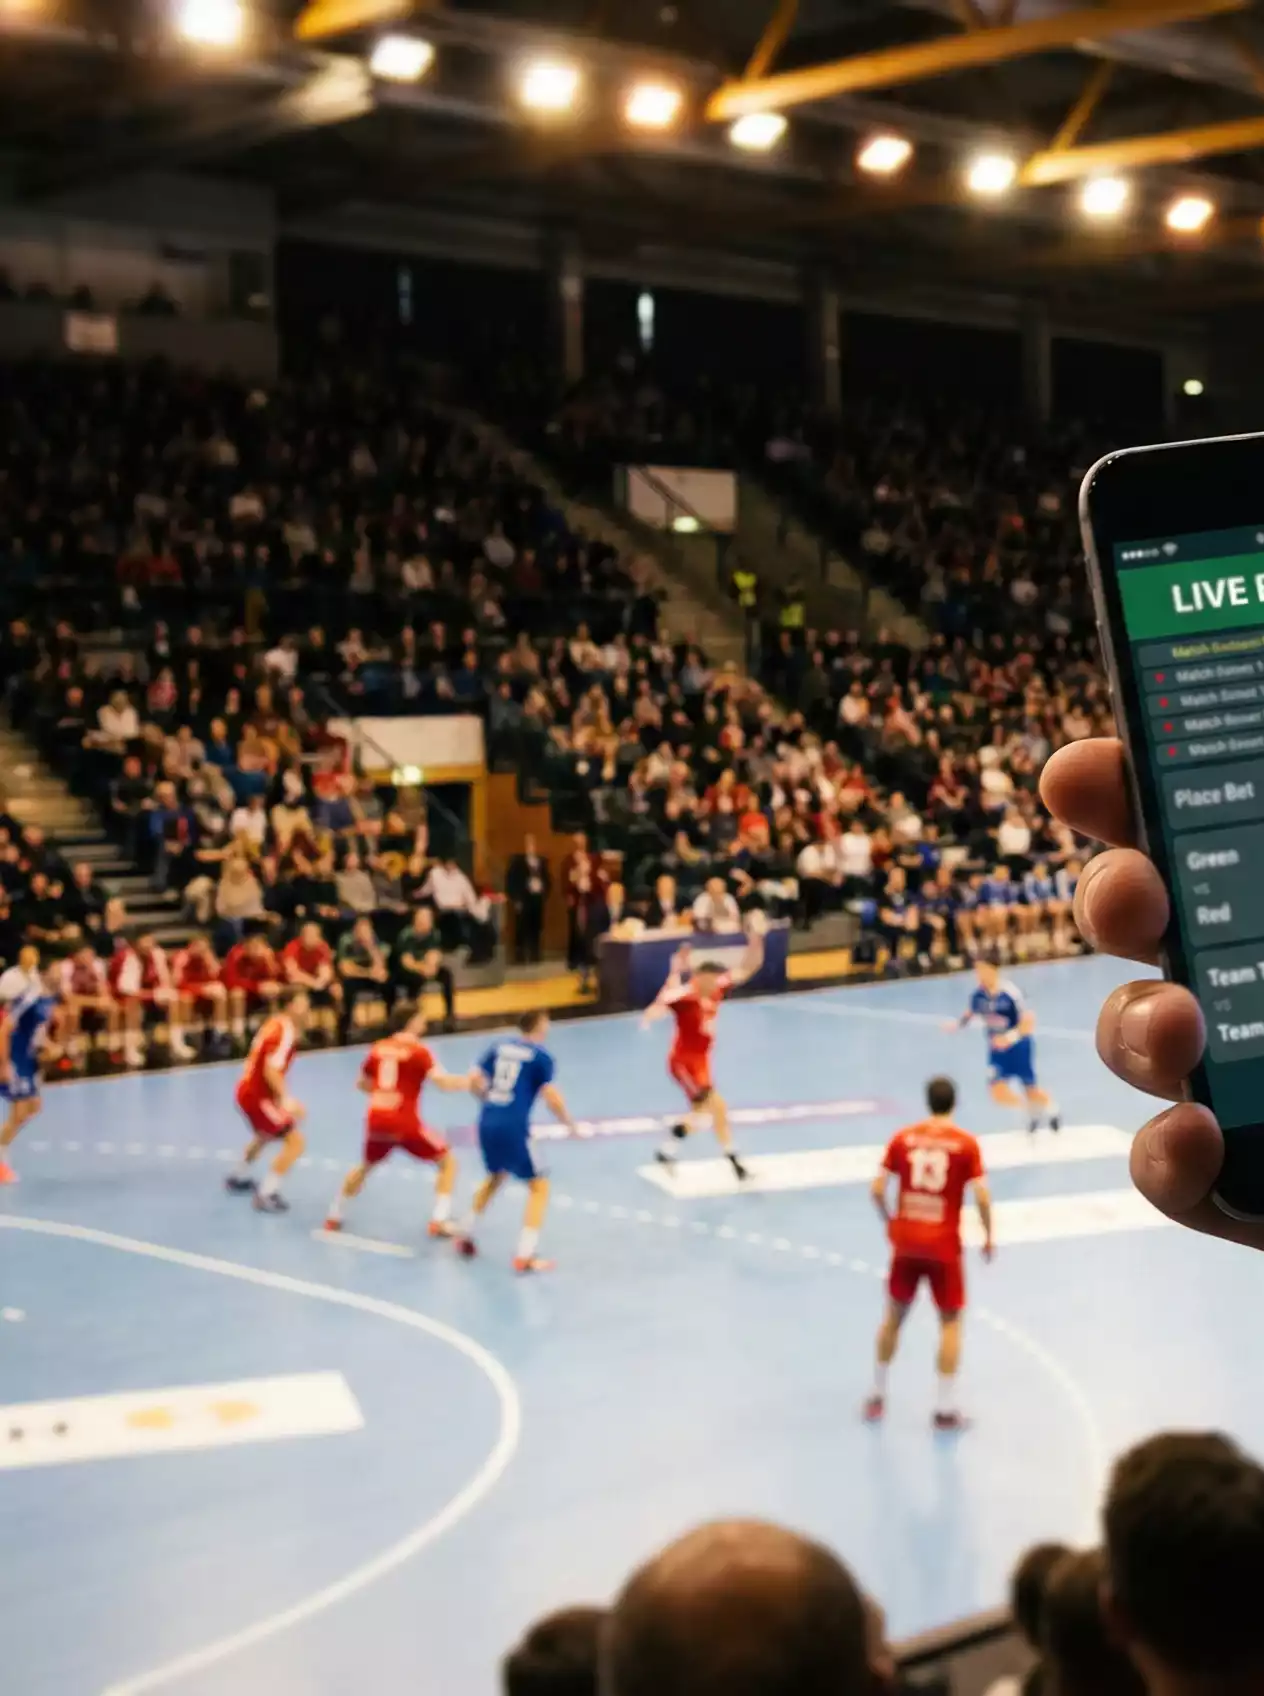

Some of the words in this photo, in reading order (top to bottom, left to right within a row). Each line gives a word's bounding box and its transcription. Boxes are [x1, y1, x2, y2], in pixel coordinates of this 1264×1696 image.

[1172, 576, 1249, 614] LIVE
[1174, 786, 1221, 808] Place
[1224, 781, 1255, 801] Bet
[1186, 849, 1240, 870] Green
[1196, 902, 1231, 925] Red
[1207, 966, 1256, 988] Team
